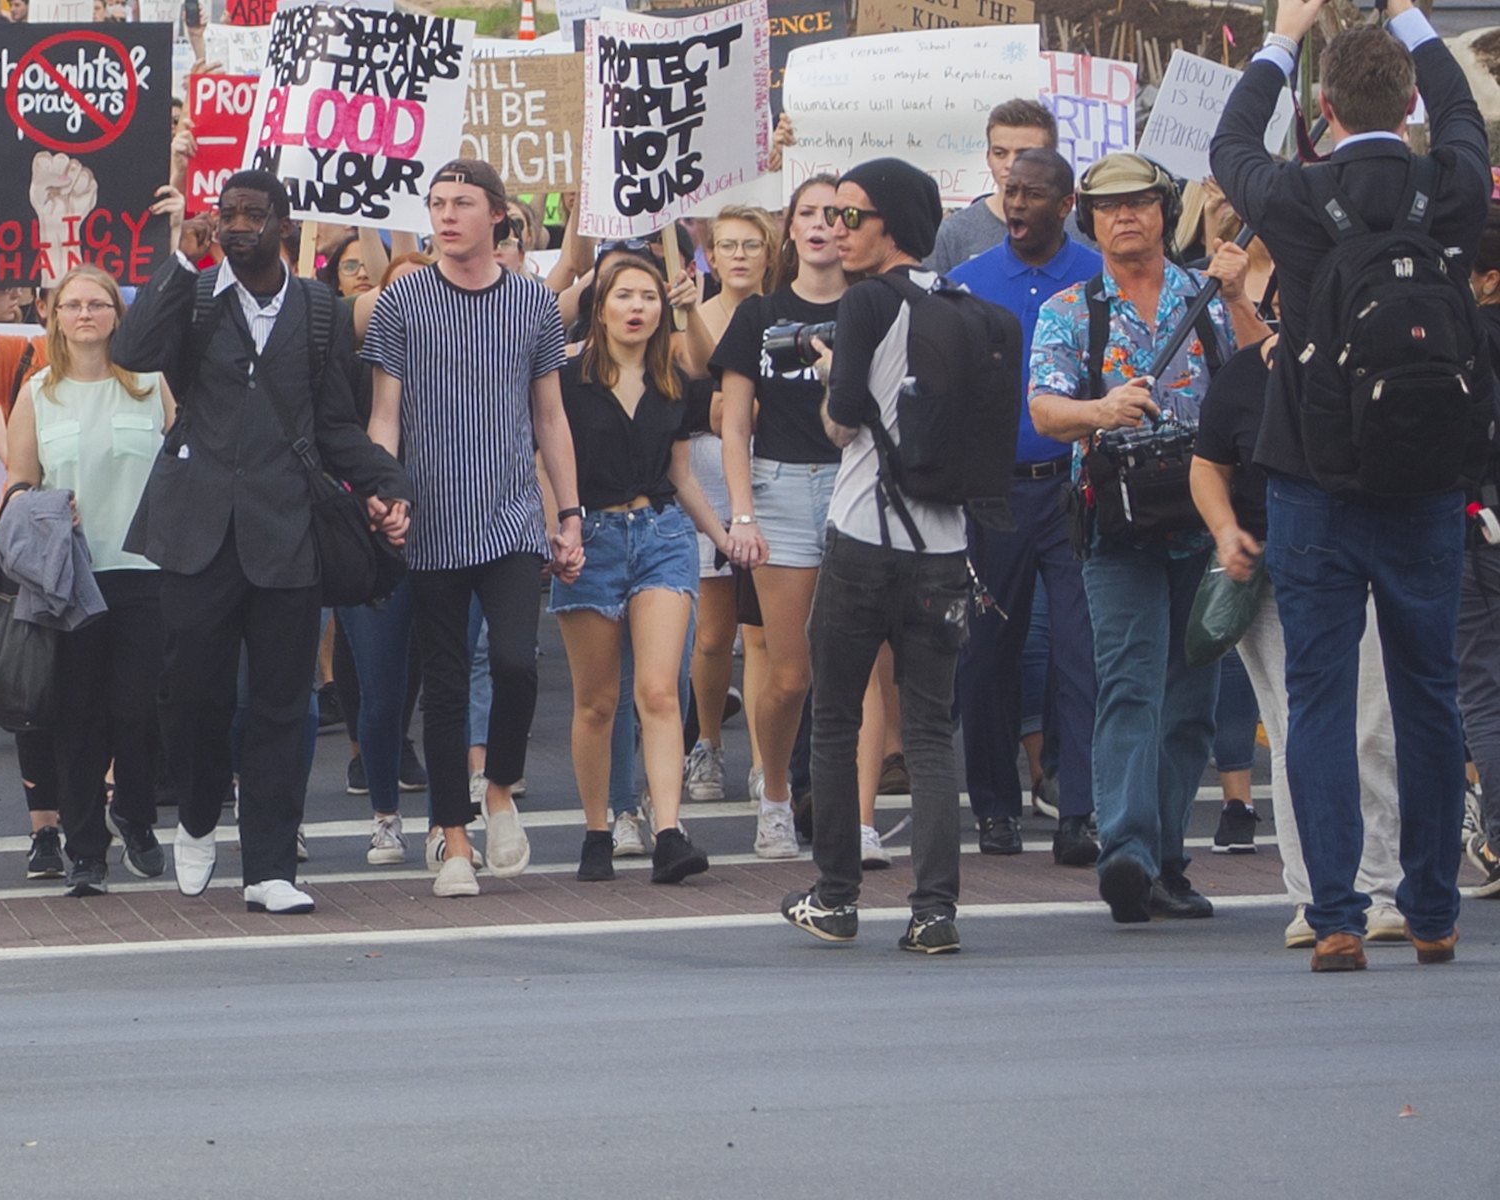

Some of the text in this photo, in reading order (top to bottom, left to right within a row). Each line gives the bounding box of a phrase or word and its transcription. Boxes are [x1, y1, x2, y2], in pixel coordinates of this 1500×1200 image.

[273, 3, 463, 52] CONGRESSIONAL
[653, 19, 688, 39] OUT
[768, 10, 832, 37] ENCE
[123, 45, 151, 90] &
[267, 30, 462, 81] REPUBLICANS
[597, 23, 743, 85] PROTECT
[871, 65, 1014, 84] so maybe Republican
[1040, 50, 1137, 107] HILD
[1174, 56, 1216, 87] HOW
[272, 59, 428, 103] YOU HAVE
[601, 74, 708, 129] PEOPLE
[787, 94, 860, 113] lawmakers
[944, 98, 956, 112] to
[16, 91, 124, 141] prayers
[259, 85, 425, 160] BLOOD
[501, 89, 548, 128] BE
[613, 116, 704, 175] NOT
[860, 129, 895, 149] About
[906, 132, 923, 149] the
[251, 146, 424, 195] ON YOUR
[613, 151, 705, 217] GUNS
[284, 177, 391, 219] ANDS
[649, 208, 672, 231] IS
[679, 169, 744, 215] ENOUGH
